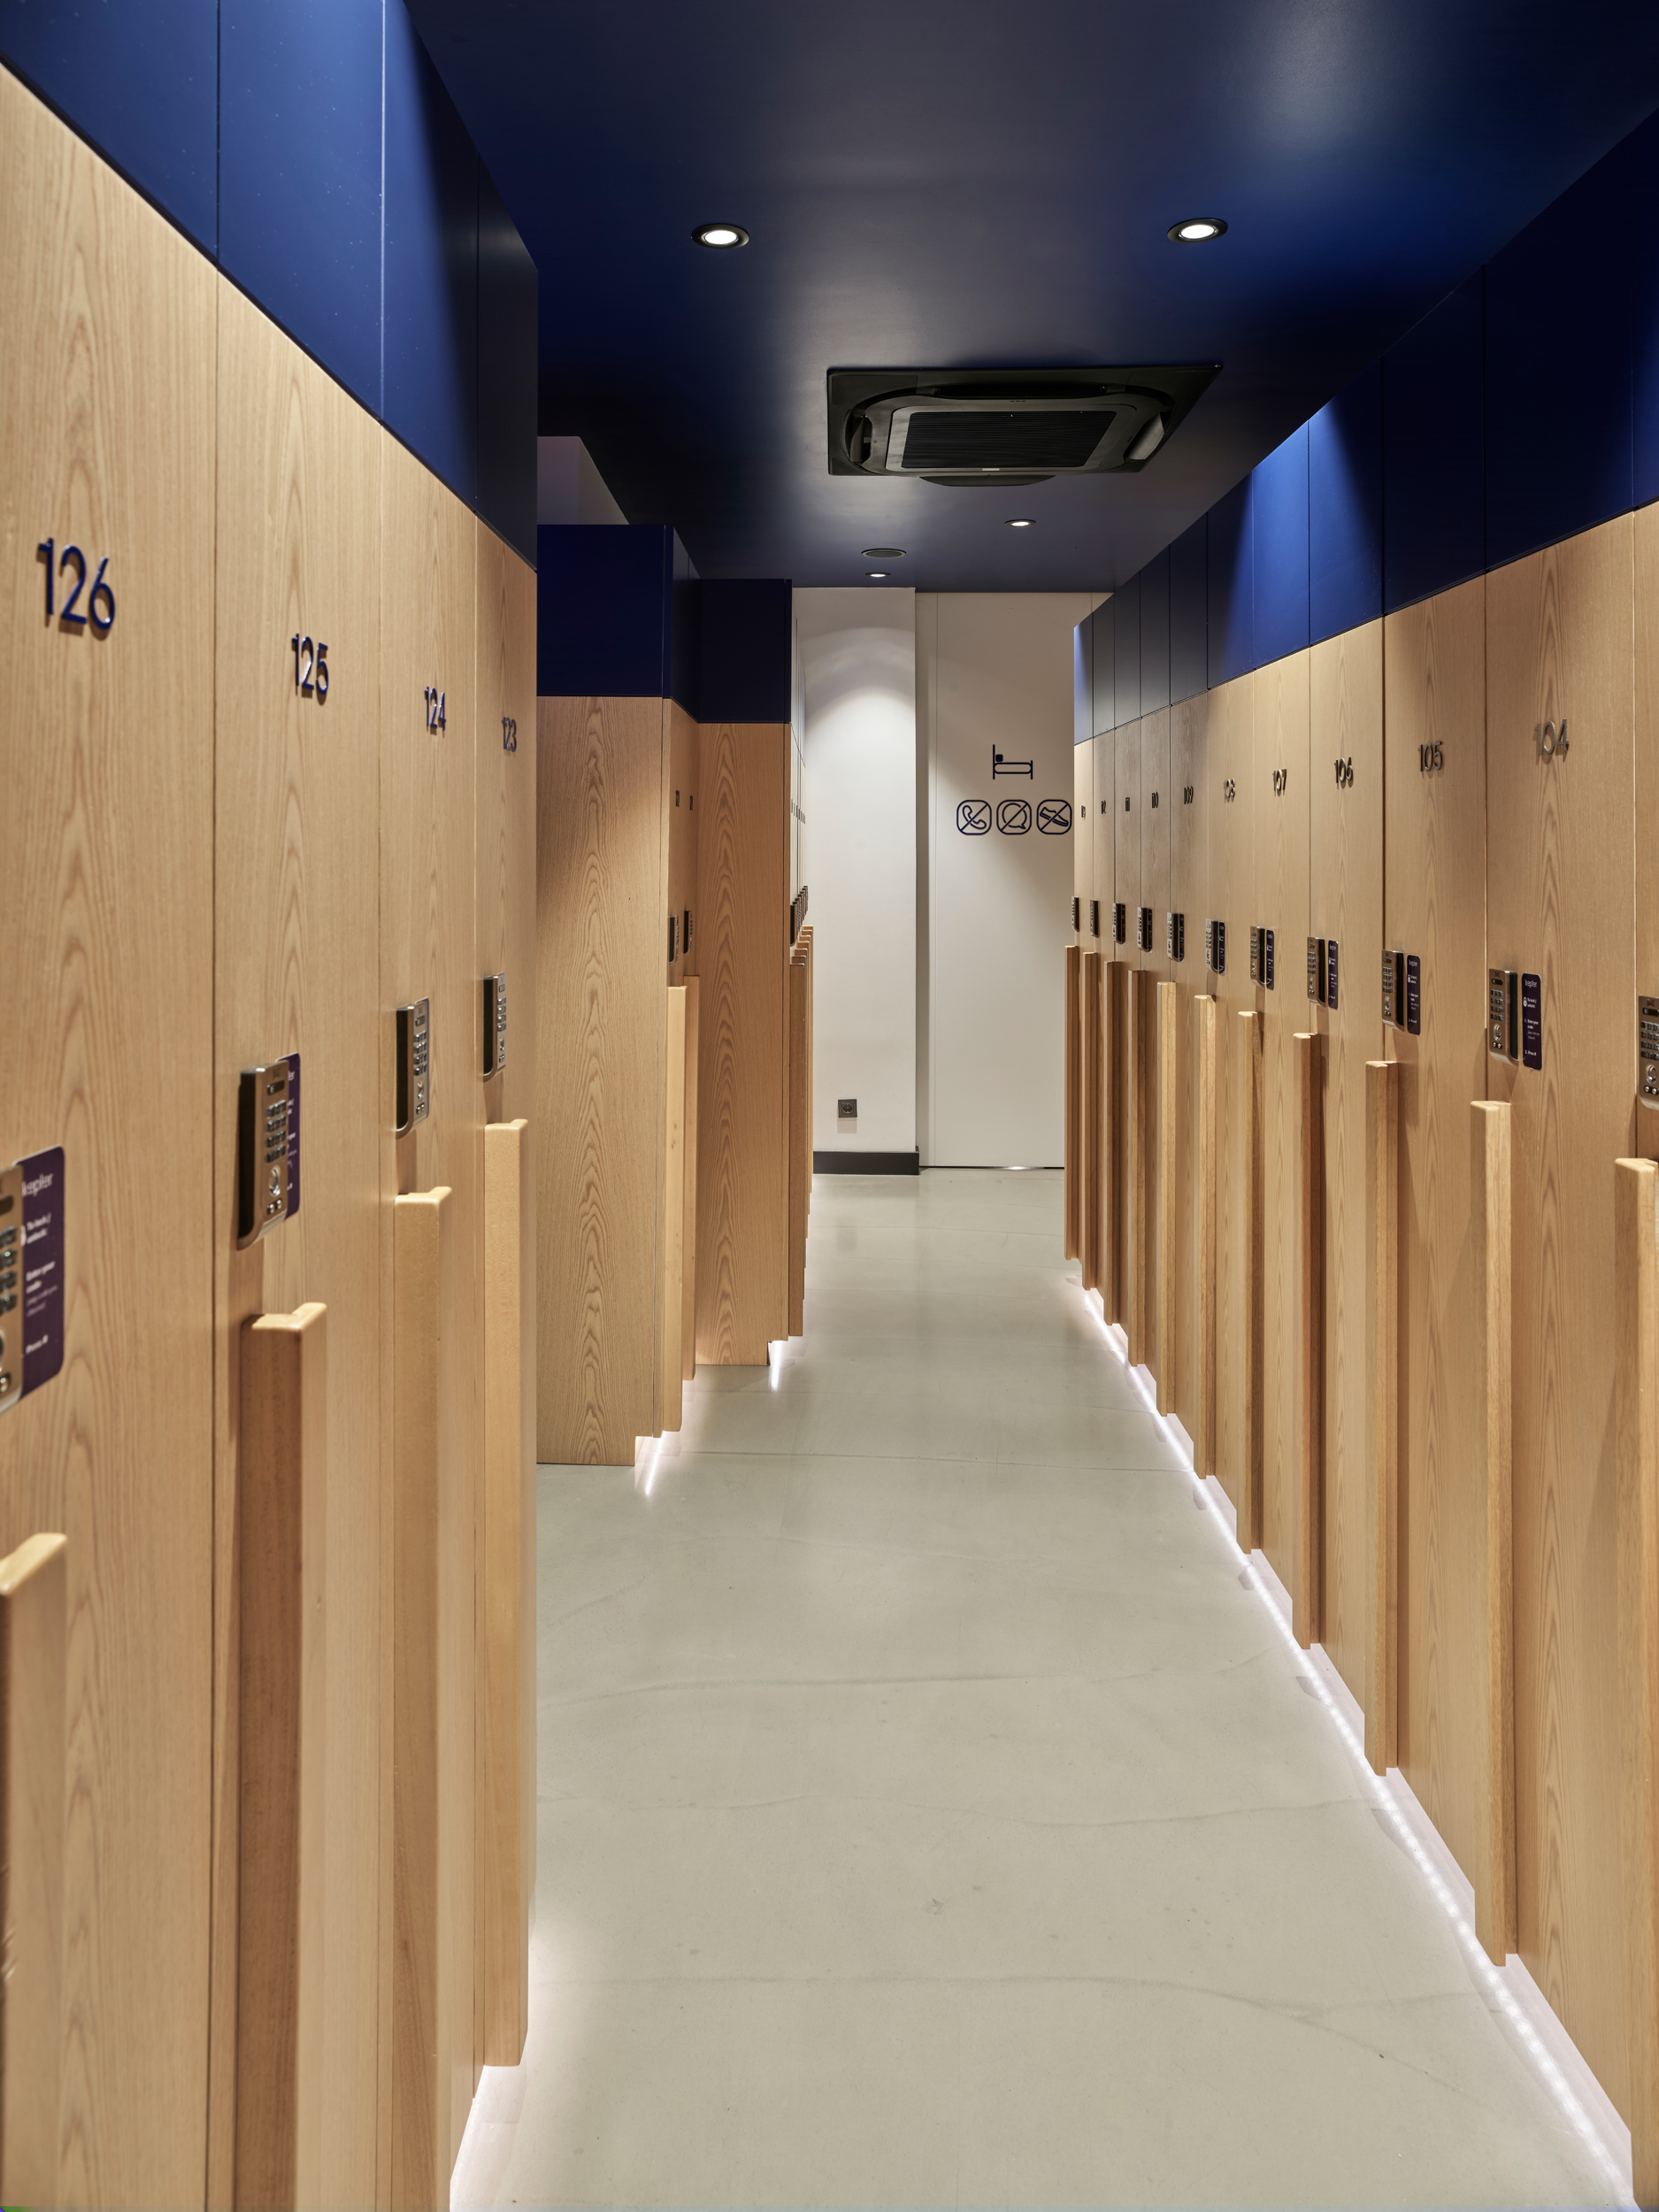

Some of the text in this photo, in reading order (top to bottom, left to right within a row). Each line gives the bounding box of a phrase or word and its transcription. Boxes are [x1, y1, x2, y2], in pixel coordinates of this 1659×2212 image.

[39, 537, 116, 630] 126
[292, 633, 330, 695] 125
[425, 686, 447, 731] 124
[502, 717, 518, 752] 123
[1534, 718, 1570, 757] 104
[1334, 757, 1354, 785] 106
[1417, 741, 1443, 772] 105
[1224, 778, 1236, 799] 108
[1272, 768, 1287, 792] 107
[1184, 786, 1194, 805] 109
[1525, 979, 1538, 988] kepler
[21, 1173, 54, 1197] kepler
